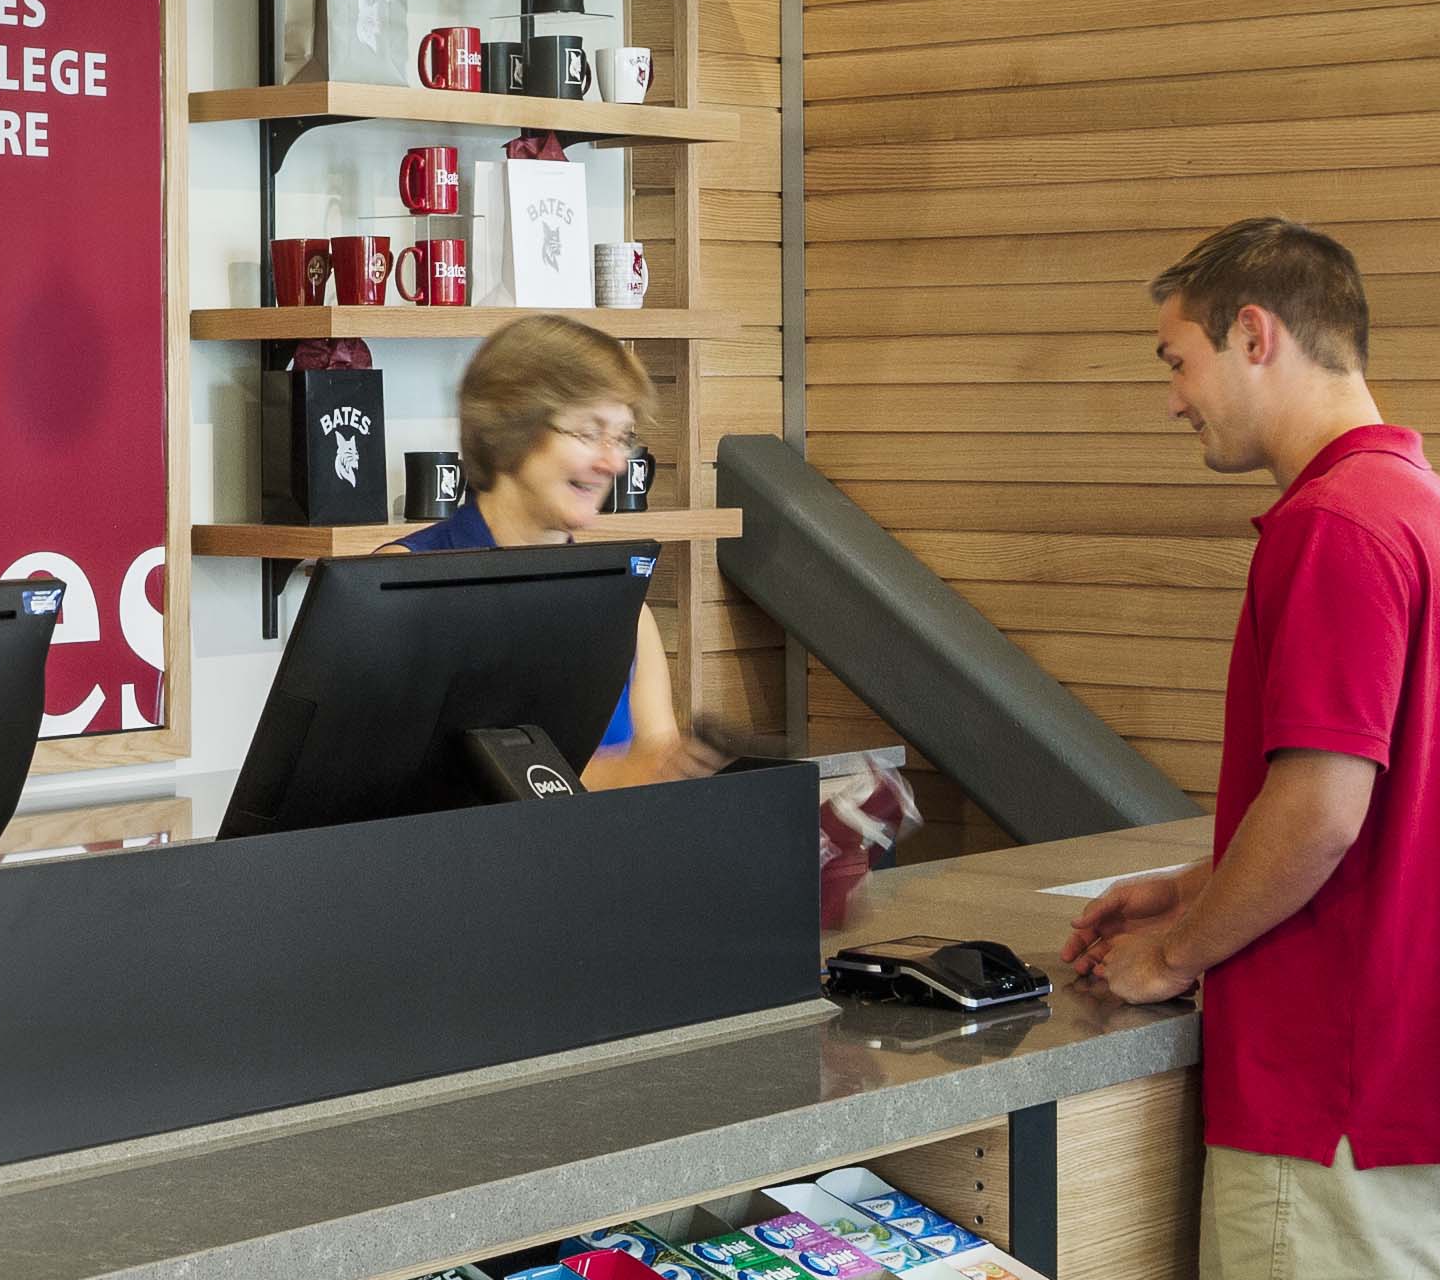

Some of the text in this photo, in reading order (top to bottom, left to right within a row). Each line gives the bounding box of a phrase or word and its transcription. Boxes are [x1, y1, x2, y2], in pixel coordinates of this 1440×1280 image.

[526, 198, 574, 226] BATES
[320, 406, 372, 436] BATES
[534, 777, 567, 797] DELL
[766, 1221, 815, 1247] Orbit
[705, 1239, 756, 1263] Orbit
[812, 1249, 861, 1272] Orbit
